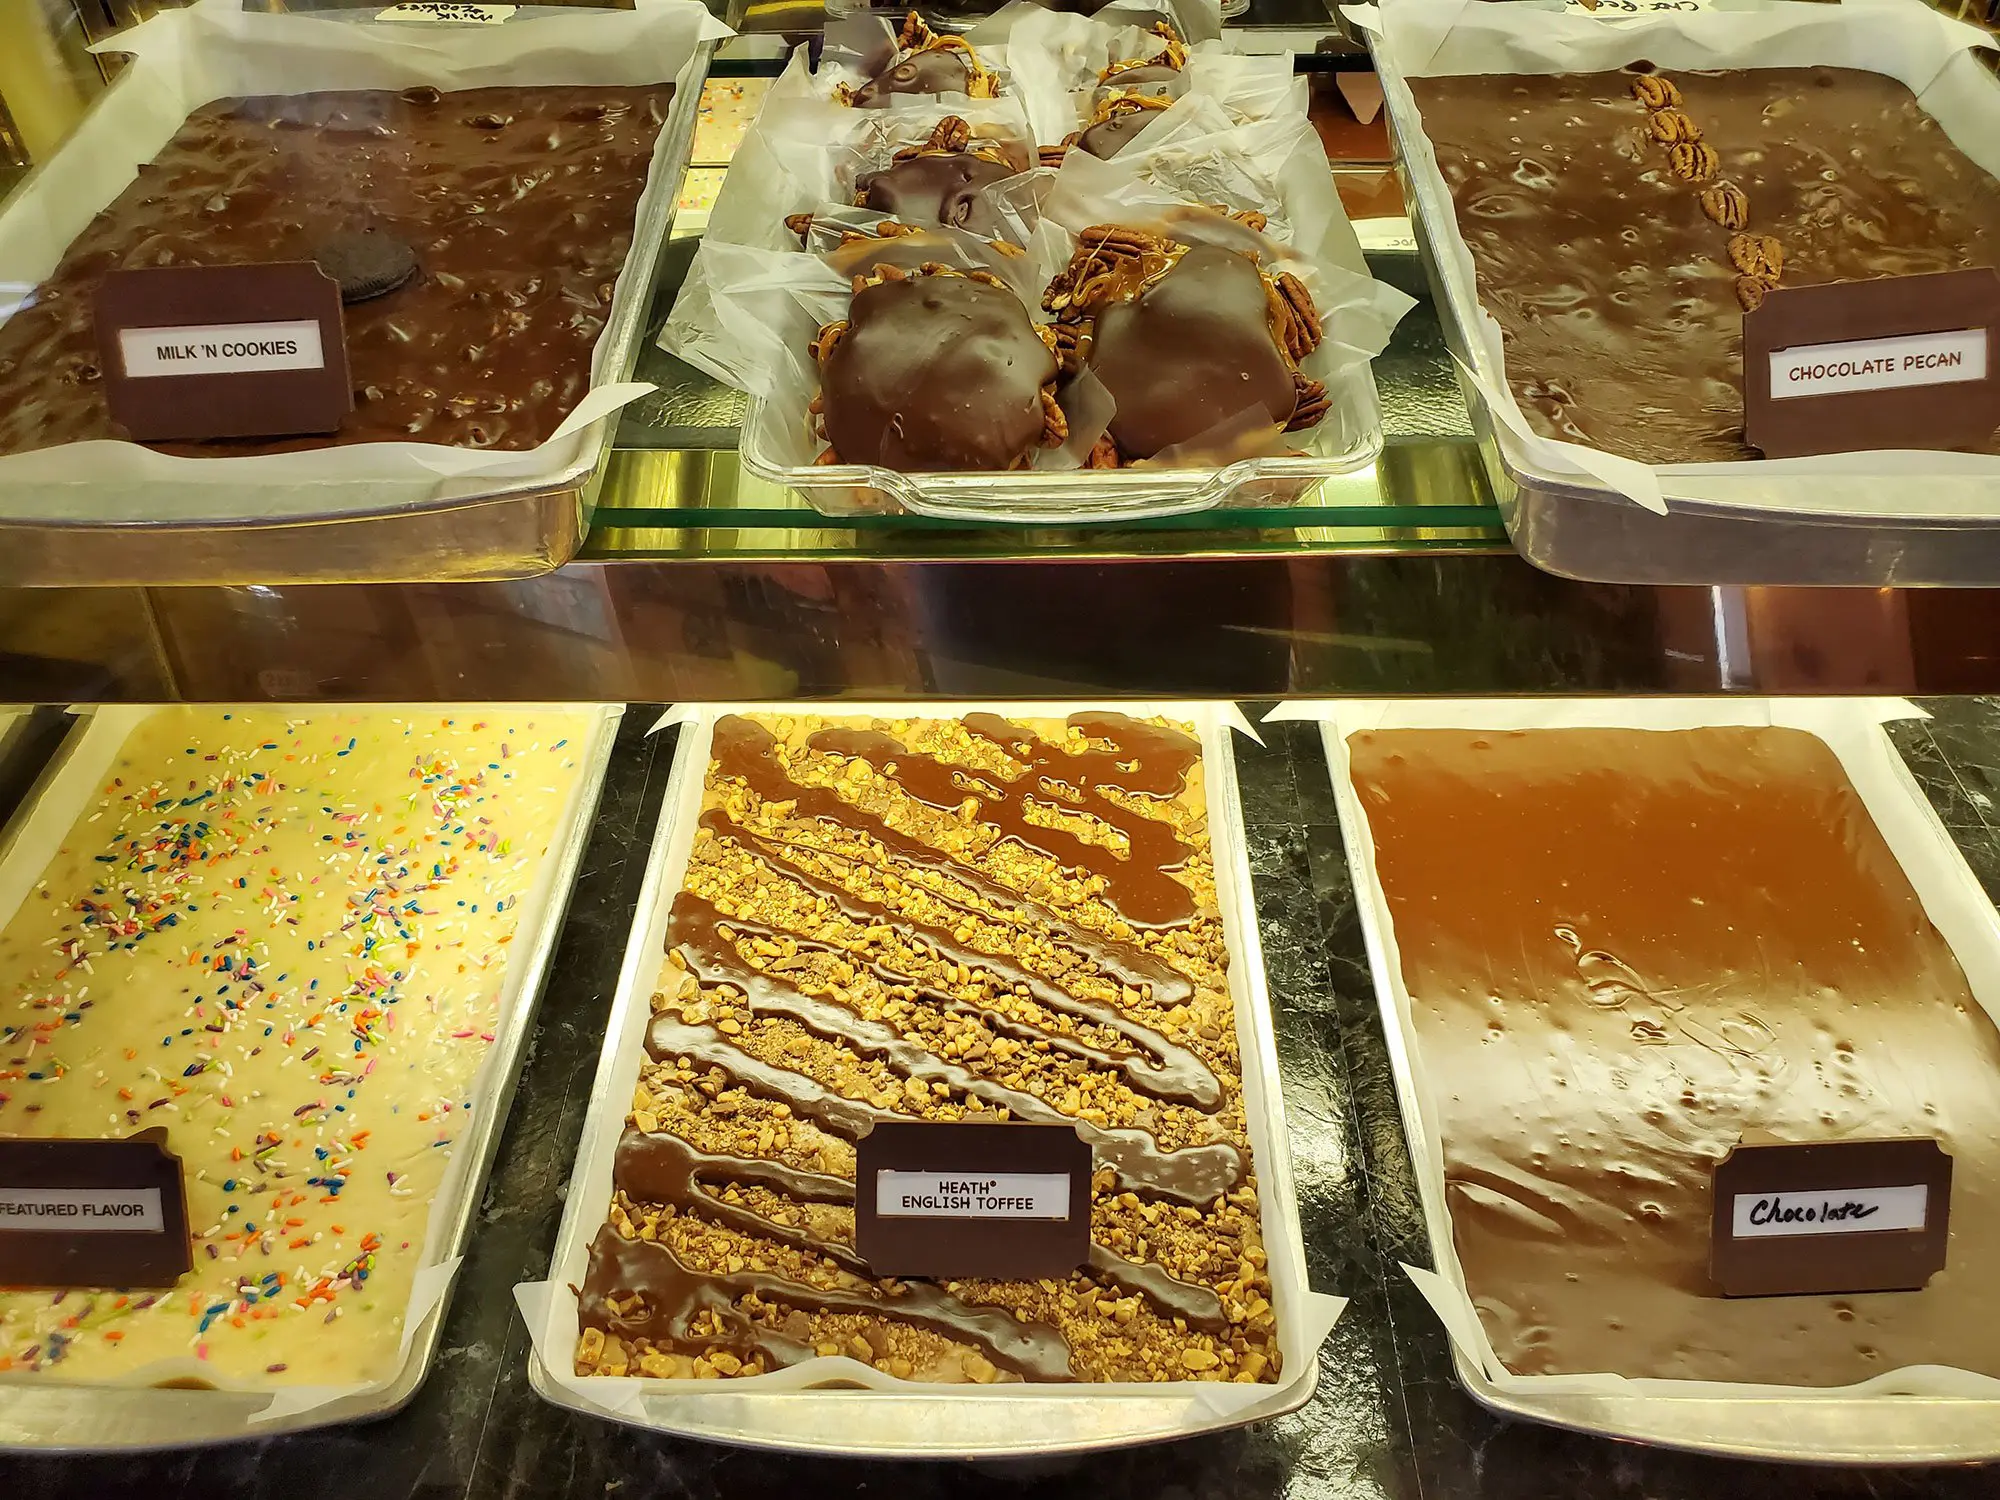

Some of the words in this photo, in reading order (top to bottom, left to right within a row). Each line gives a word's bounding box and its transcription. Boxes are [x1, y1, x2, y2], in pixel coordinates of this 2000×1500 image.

[156, 345, 198, 360] MILK
[222, 340, 298, 357] COOKIES
[1788, 357, 1895, 382] CHOCOLATE
[1903, 351, 1962, 371] PECAN
[0, 1202, 78, 1216] FEATURED
[82, 1203, 144, 1216] FLAVOR
[902, 1195, 971, 1209] ENGLISH
[975, 1196, 1034, 1210] TOFFEE
[1749, 1196, 1879, 1226] Chocolate
